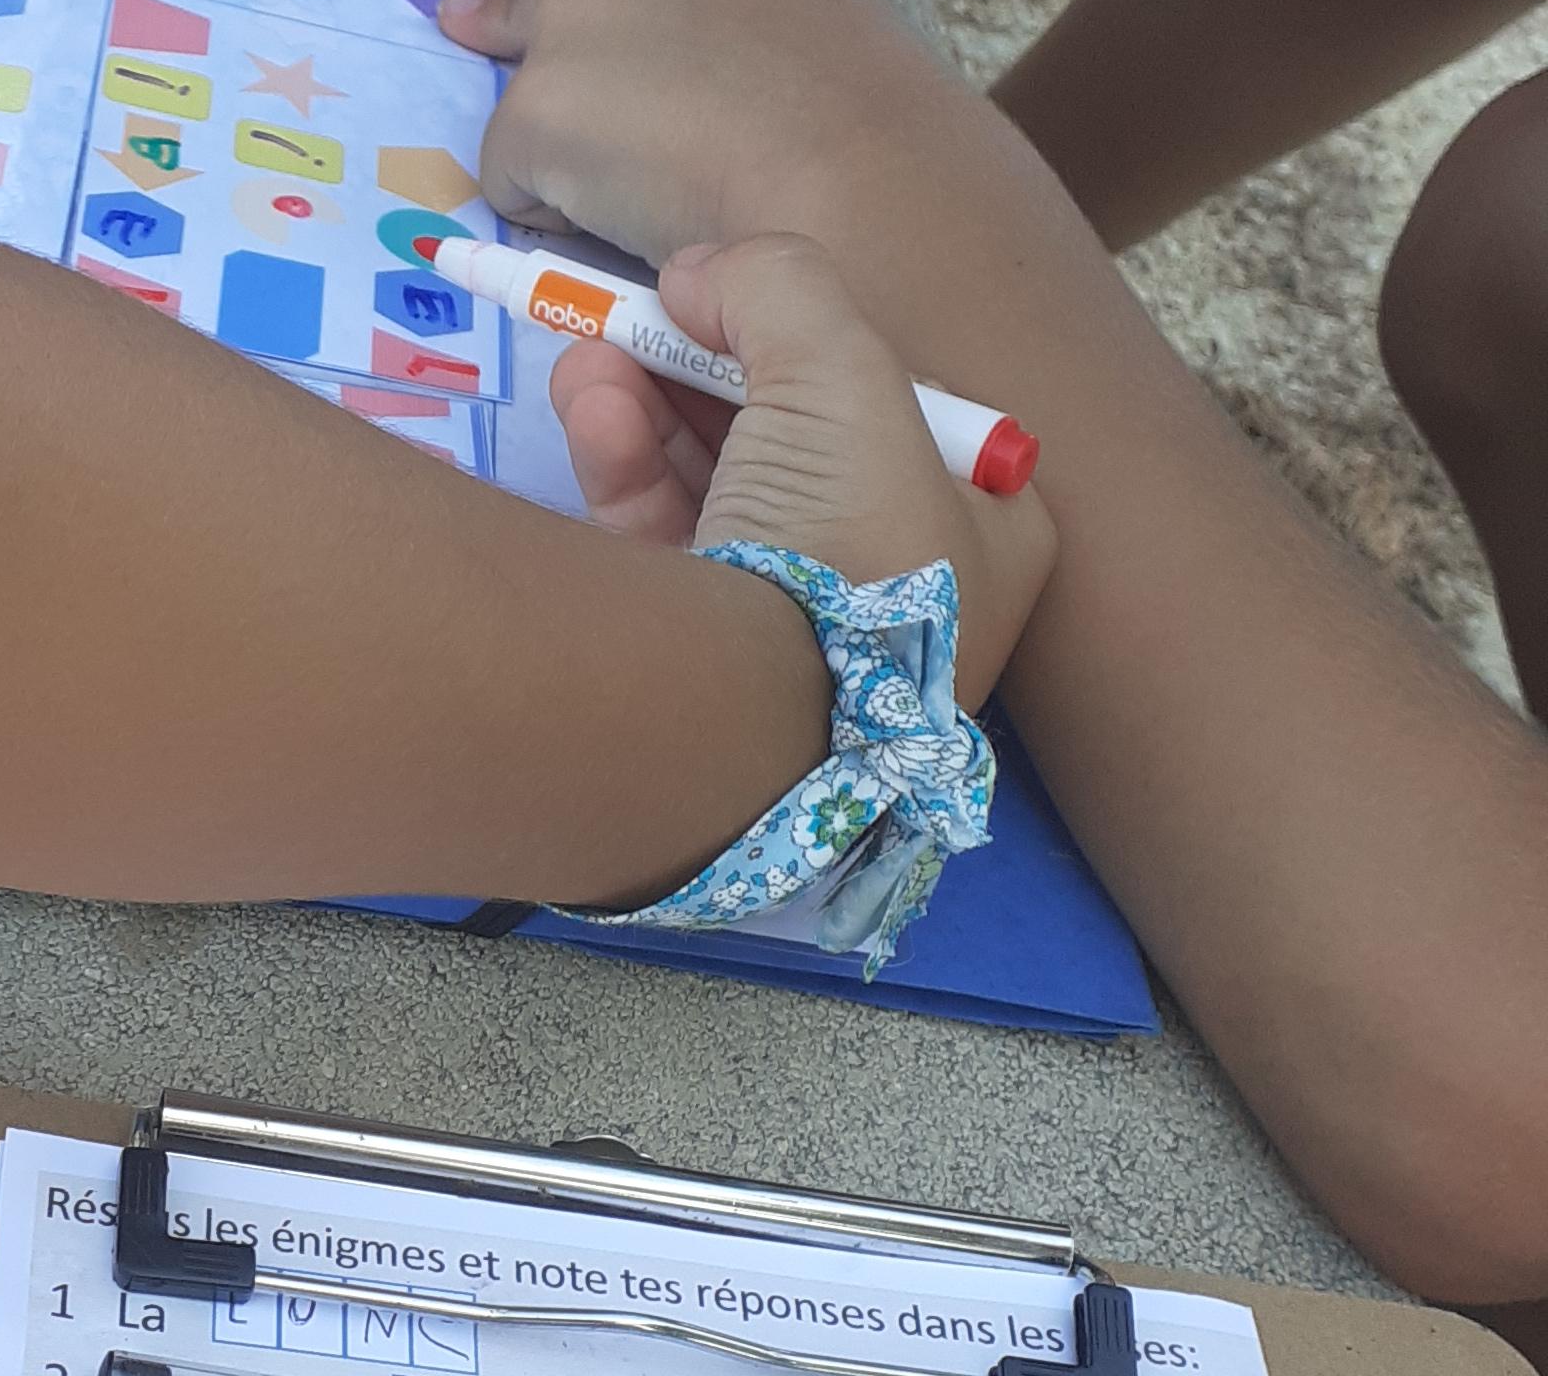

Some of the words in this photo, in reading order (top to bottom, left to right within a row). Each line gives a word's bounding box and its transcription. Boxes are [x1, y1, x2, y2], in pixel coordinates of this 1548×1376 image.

[533, 295, 600, 338] nobo
[47, 1186, 192, 1238] Réss
[206, 1207, 259, 1250] les
[272, 1218, 446, 1274] énigmes
[458, 1249, 501, 1282] et
[514, 1259, 609, 1296] note
[619, 1268, 684, 1305] tes
[696, 1277, 886, 1333] réponses
[897, 1304, 997, 1347] dans
[1008, 1315, 1066, 1354] les
[49, 1283, 75, 1321] 1
[119, 1291, 166, 1334] La
